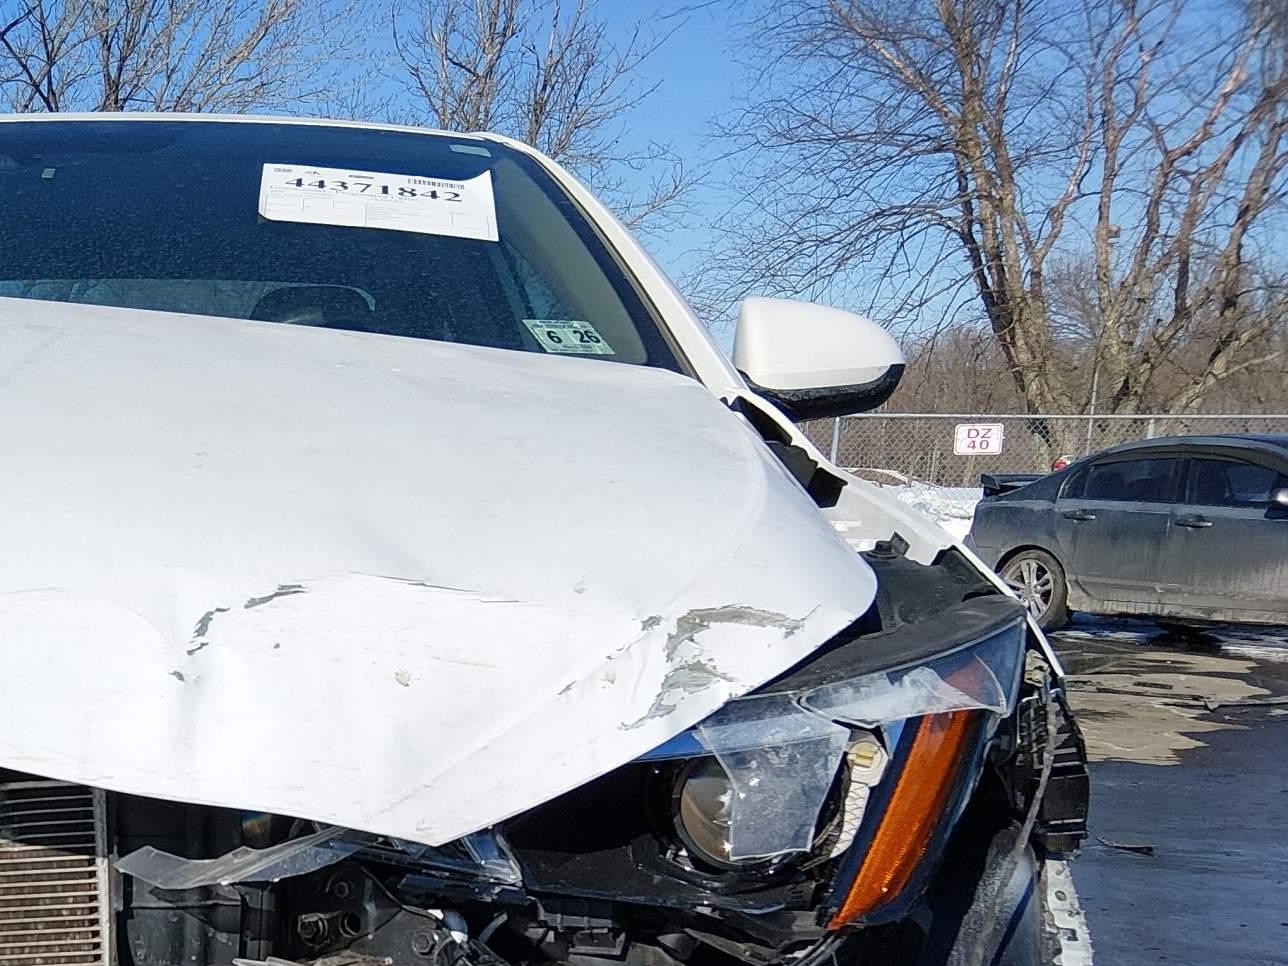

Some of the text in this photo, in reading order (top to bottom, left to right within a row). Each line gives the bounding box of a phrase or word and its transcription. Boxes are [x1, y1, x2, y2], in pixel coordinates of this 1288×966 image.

[285, 178, 463, 203] 44371842
[546, 330, 601, 344] 6 26
[967, 428, 993, 439] DZ
[966, 439, 990, 450] 40
